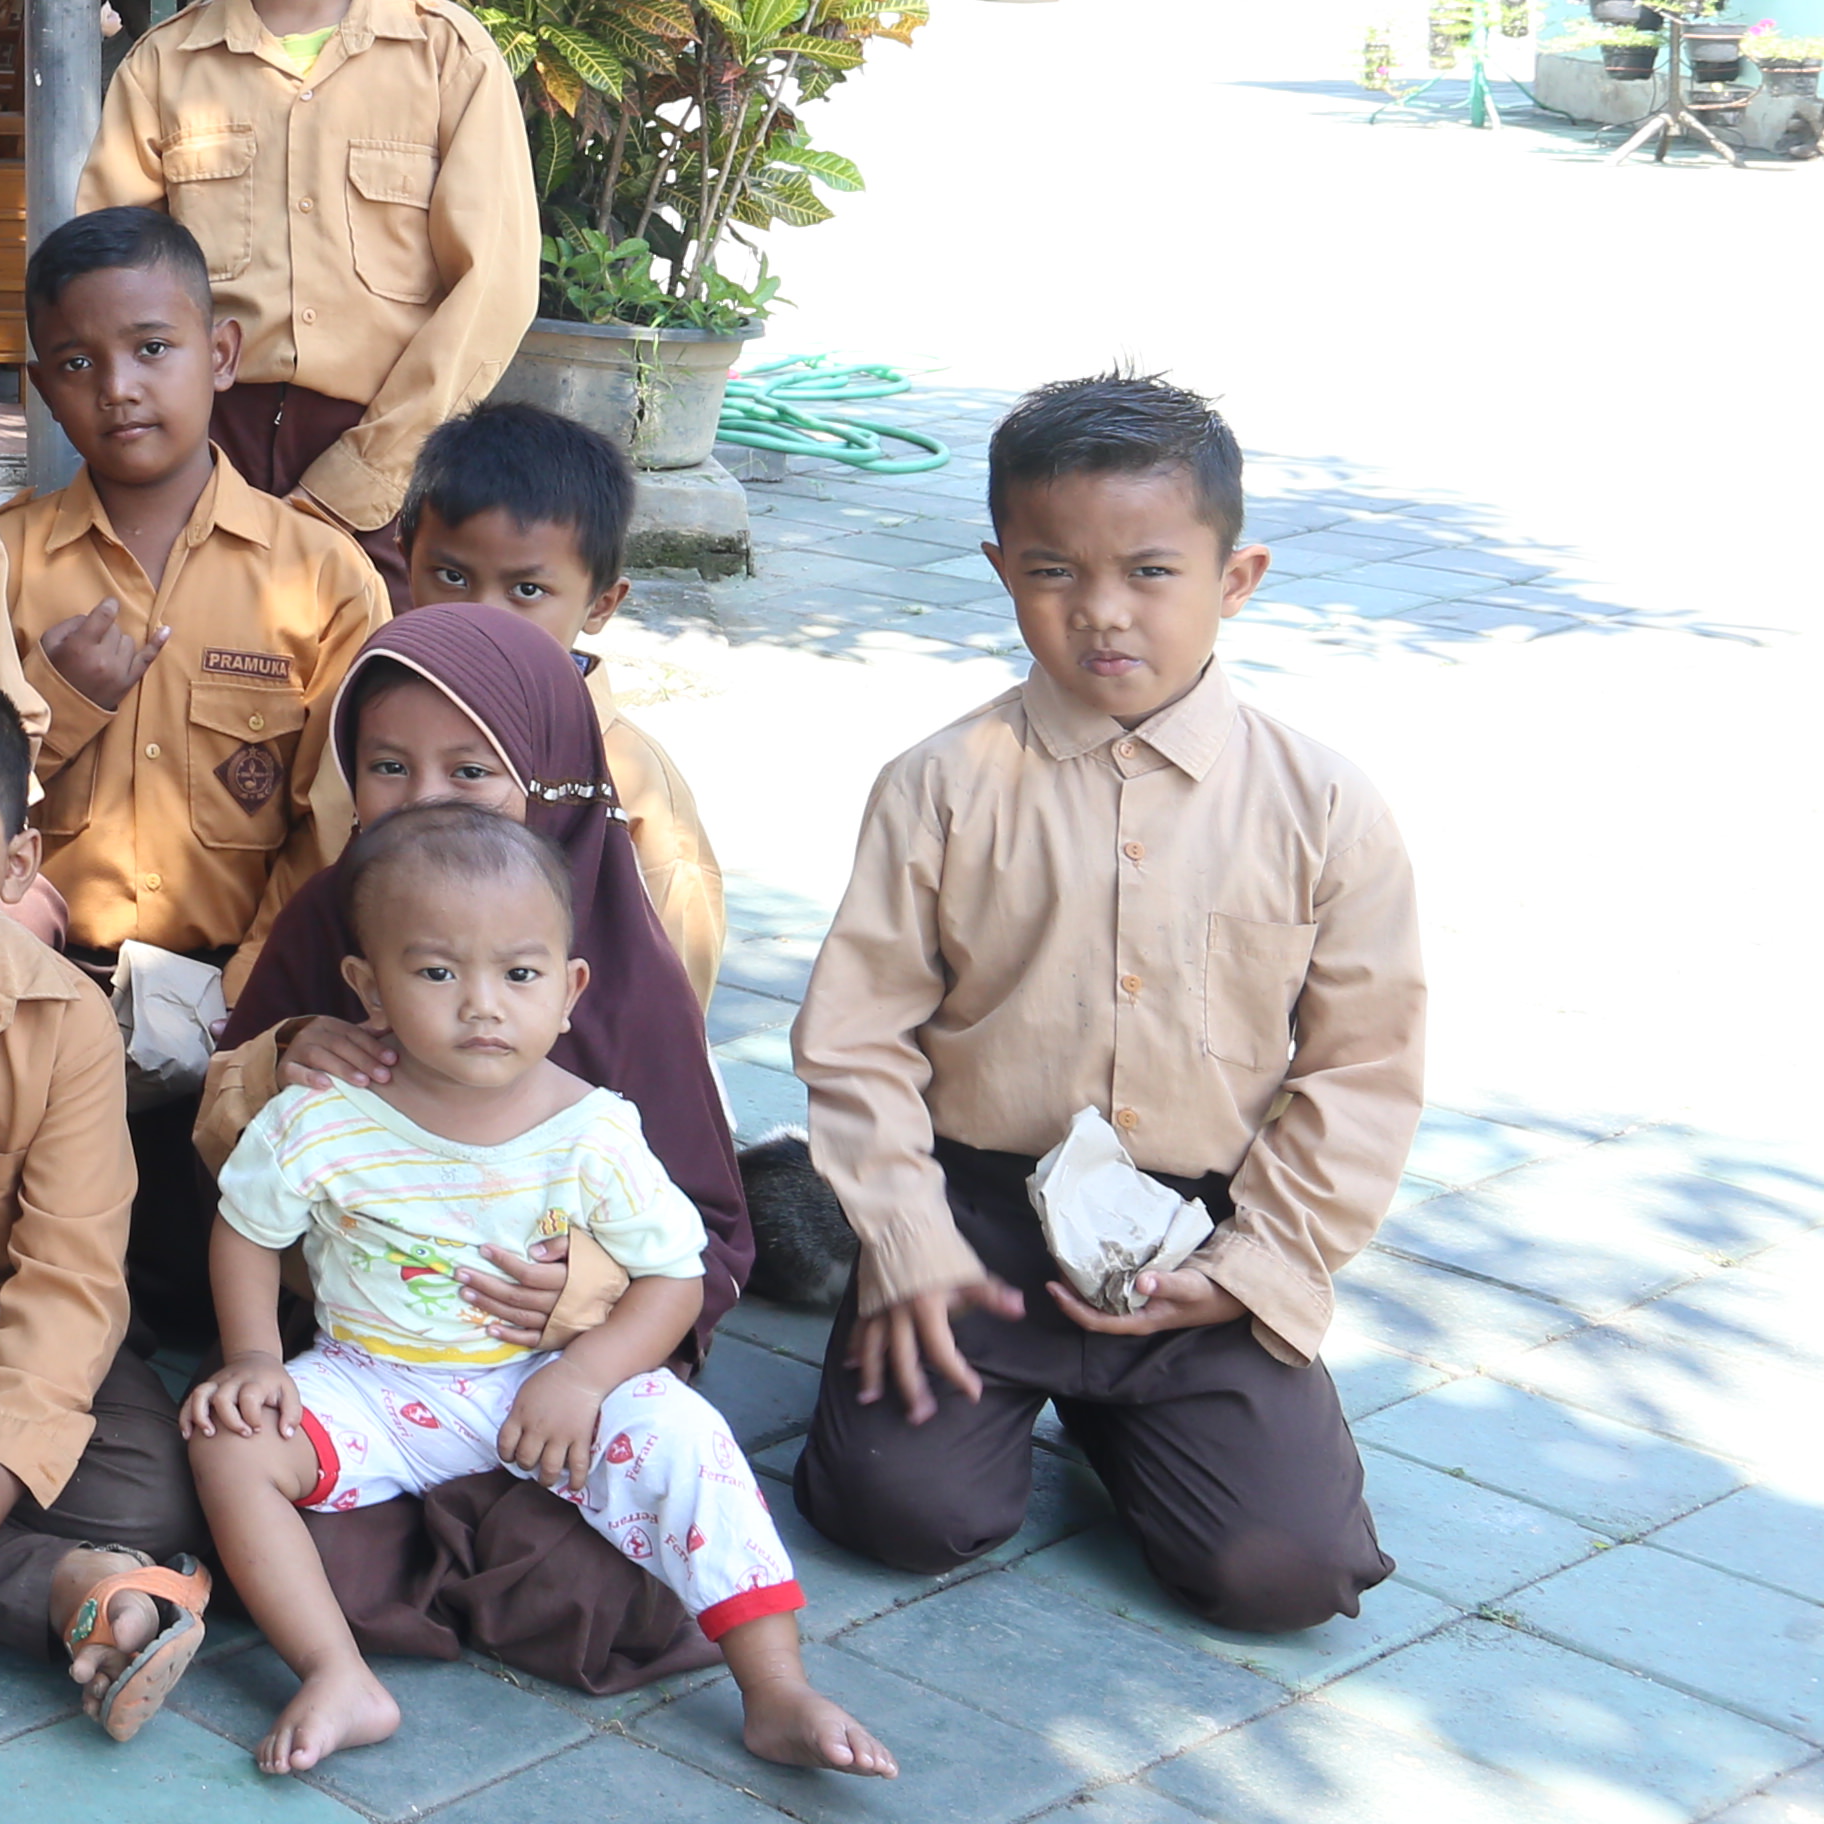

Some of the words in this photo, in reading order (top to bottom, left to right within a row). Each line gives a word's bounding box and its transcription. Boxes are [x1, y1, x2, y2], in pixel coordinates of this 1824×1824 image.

[208, 653, 288, 676] PRAMUKA
[624, 1432, 660, 1483] Ferrari
[607, 1510, 660, 1532] Ferrari
